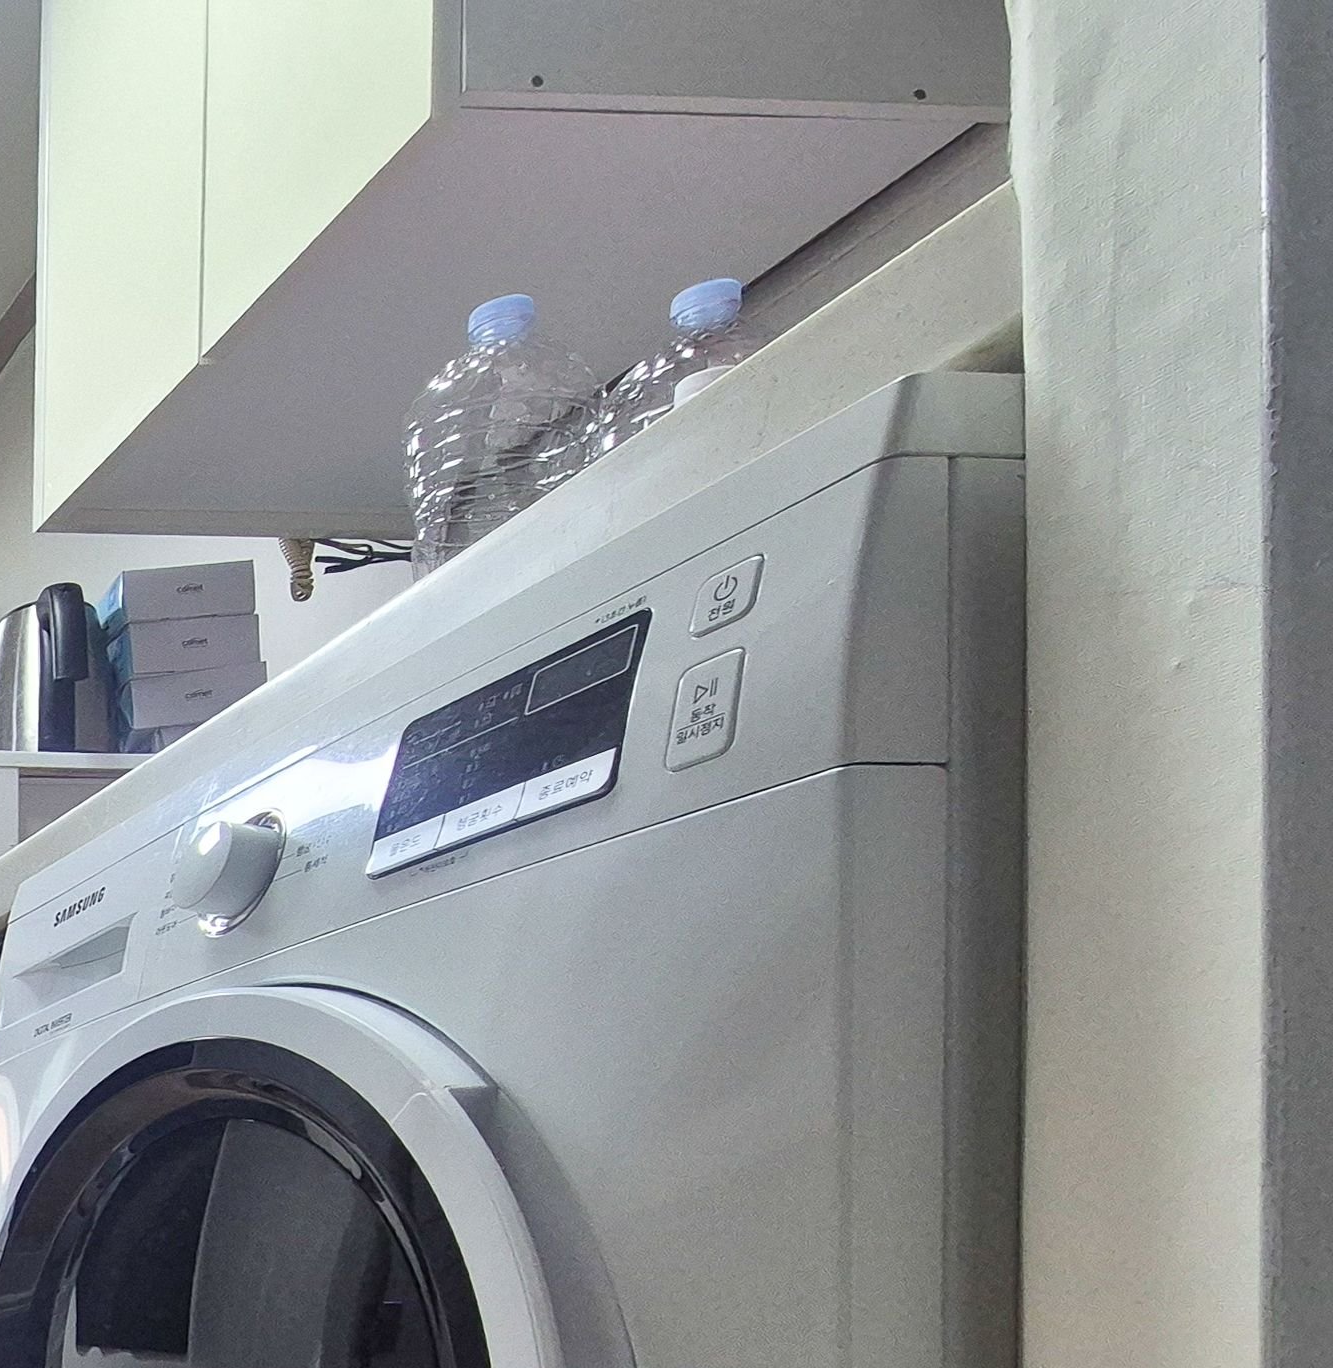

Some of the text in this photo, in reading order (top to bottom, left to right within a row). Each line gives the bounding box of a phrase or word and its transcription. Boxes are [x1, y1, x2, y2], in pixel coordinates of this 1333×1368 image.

[708, 599, 736, 621] 전원
[690, 703, 717, 723] 동작
[676, 716, 725, 745] 일시정지
[538, 769, 594, 800] 종료예약
[53, 886, 106, 928] SAMSUNG
